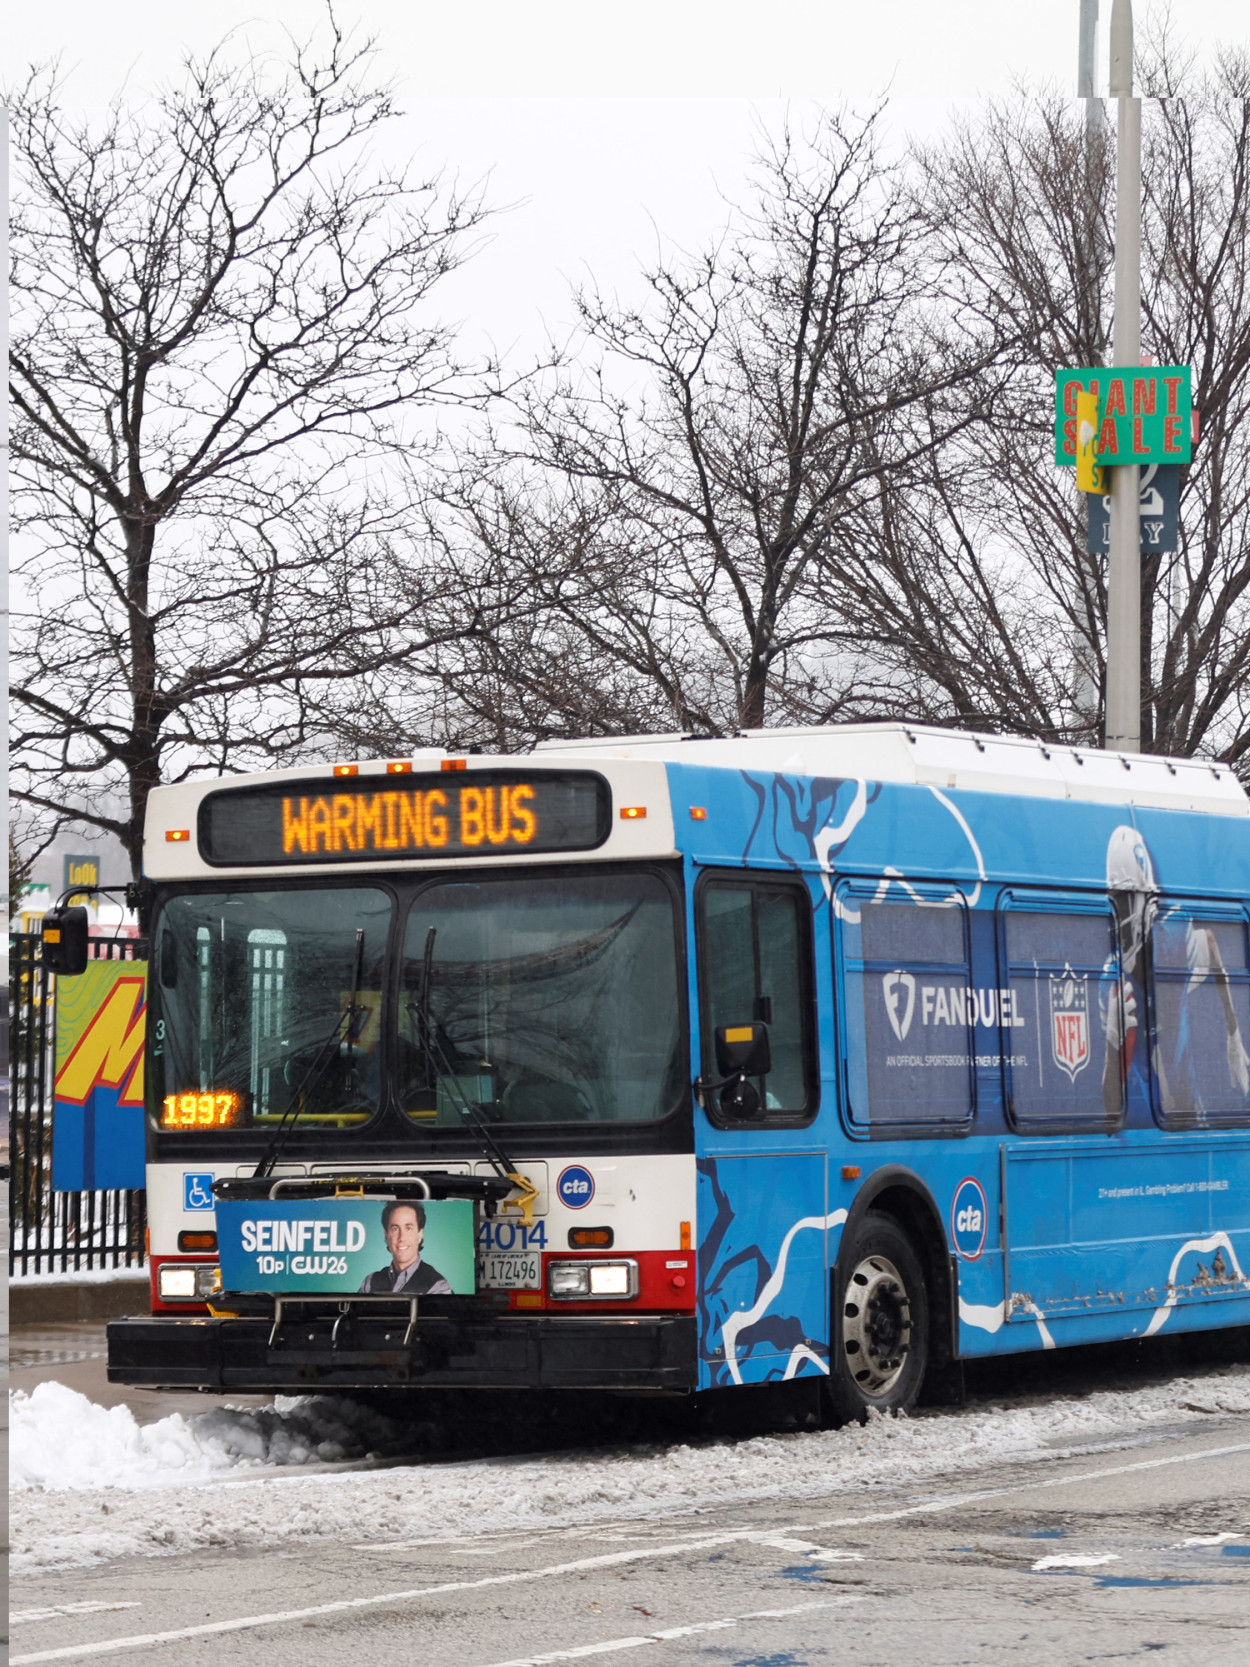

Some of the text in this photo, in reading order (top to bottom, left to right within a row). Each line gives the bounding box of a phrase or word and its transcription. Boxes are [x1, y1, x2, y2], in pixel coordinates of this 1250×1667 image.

[282, 784, 536, 853] WARMING BUS
[921, 986, 1025, 1028] FANDUEL
[1055, 1015, 1086, 1065] NFL
[163, 1093, 233, 1124] 1997
[562, 1179, 590, 1194] cta
[957, 1205, 981, 1232] cta
[241, 1220, 366, 1252] SEINFELD
[479, 1220, 548, 1250] 4014
[490, 1260, 536, 1280] 172496
